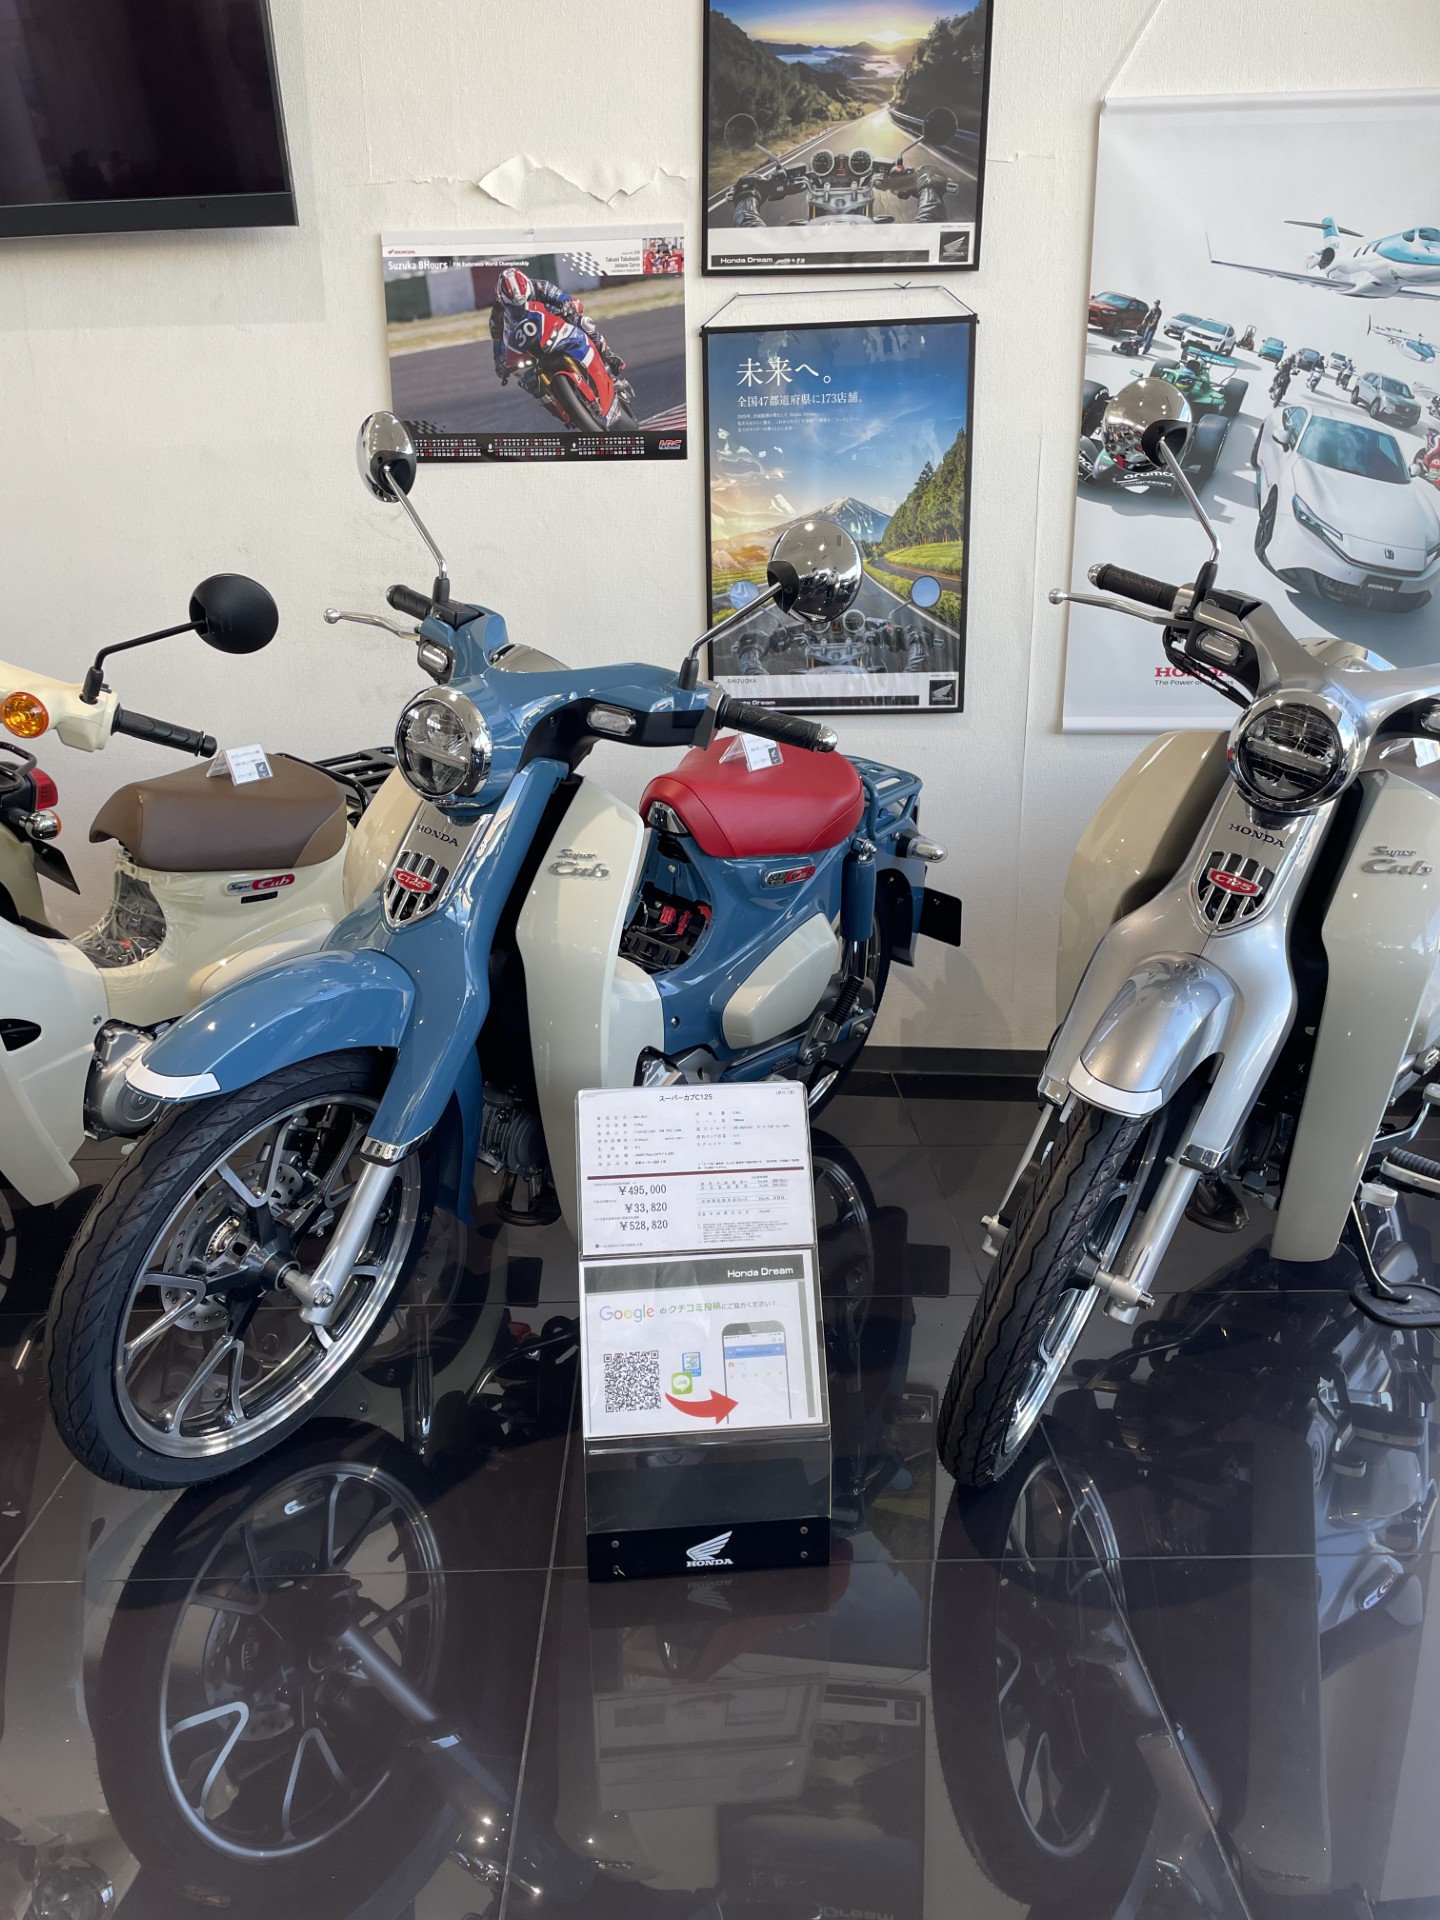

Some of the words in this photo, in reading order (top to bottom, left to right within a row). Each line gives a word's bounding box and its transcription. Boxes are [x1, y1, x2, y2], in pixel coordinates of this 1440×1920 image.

[388, 261, 417, 271] Suzuka
[418, 260, 448, 270] 8Hours
[514, 321, 538, 347] 30
[736, 356, 832, 388] 未来へ。
[737, 391, 863, 407] 全国47都道府県に173店舗。
[1367, 583, 1394, 592] HONDA
[416, 824, 459, 847] HONDA
[1228, 823, 1285, 849] HONDA
[557, 849, 598, 860] Super
[1369, 846, 1417, 857] Super
[548, 861, 610, 879] Cub
[1361, 859, 1434, 876] Cub
[257, 876, 290, 889] Cub
[1215, 874, 1253, 891] C125
[658, 1093, 713, 1102] スーパーカブC125
[619, 1184, 667, 1196] ¥495,000
[625, 1202, 668, 1213] ¥33,820
[620, 1219, 668, 1232] ¥528,820
[727, 1269, 759, 1278] Honda
[760, 1266, 794, 1276] Dream
[599, 1304, 655, 1323] Google
[686, 1558, 734, 1568] HONDA
